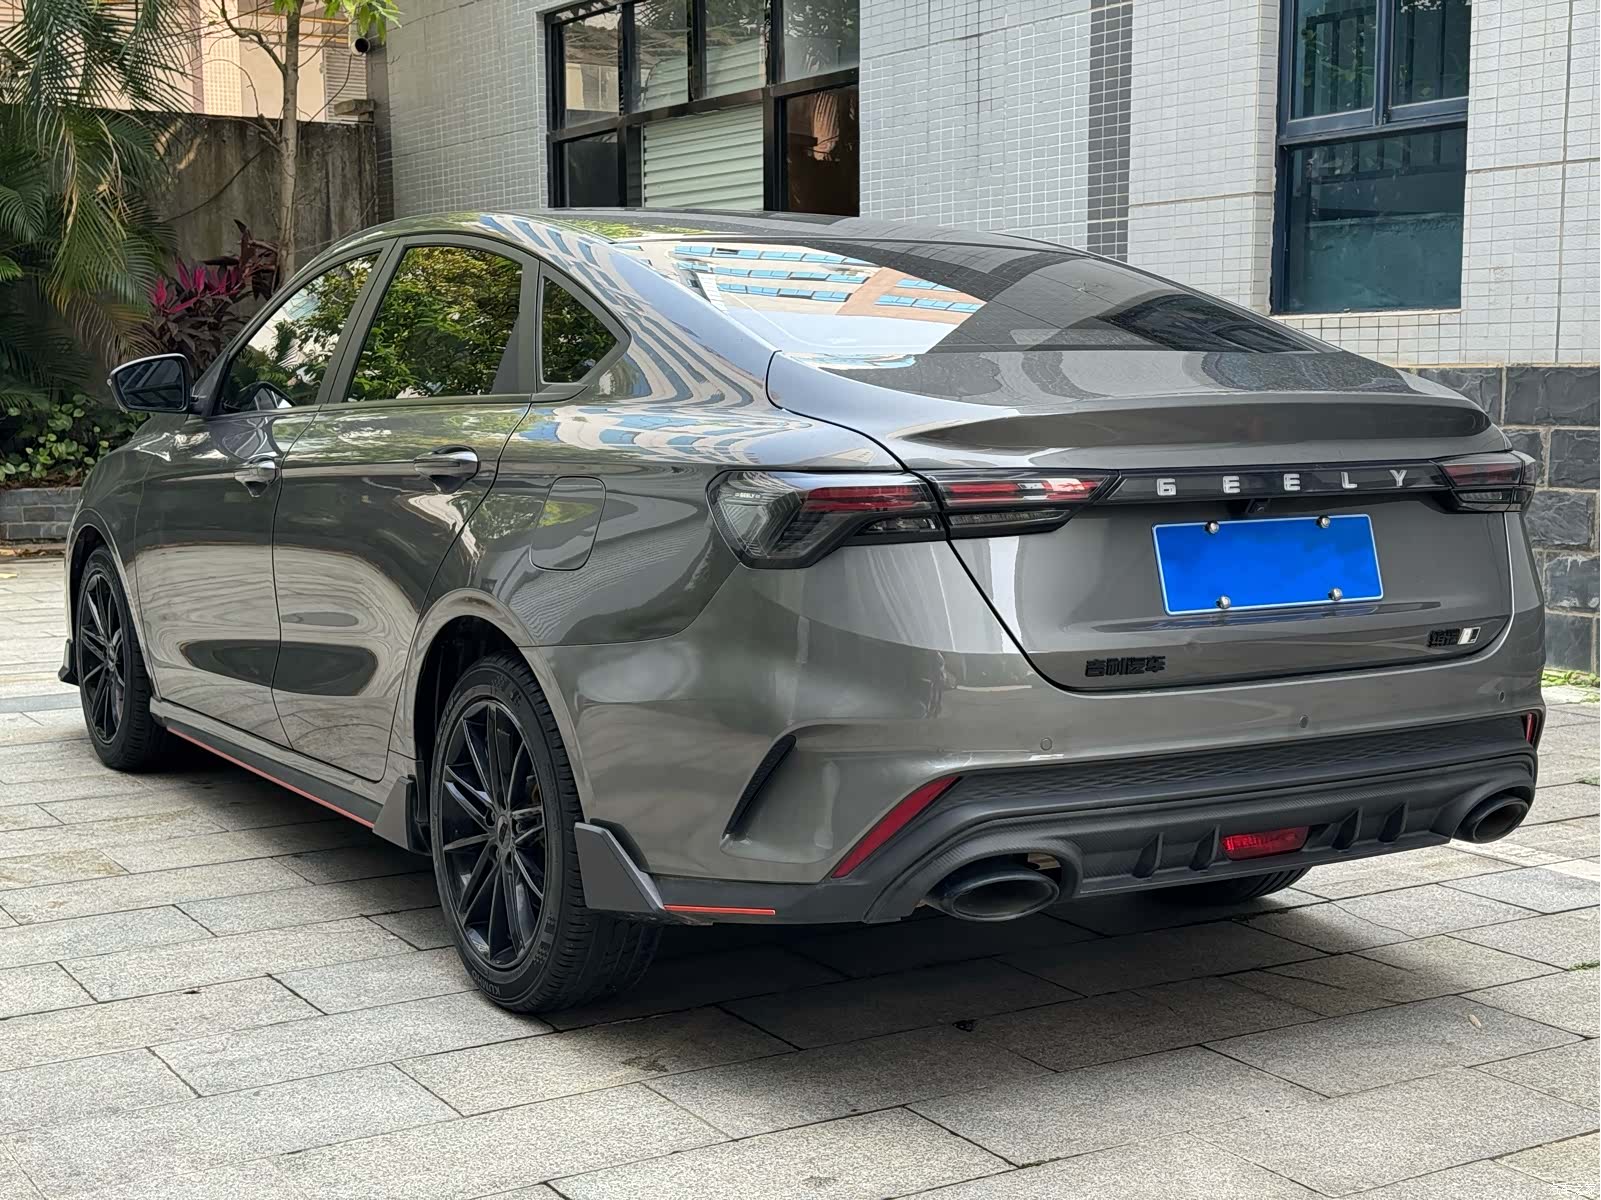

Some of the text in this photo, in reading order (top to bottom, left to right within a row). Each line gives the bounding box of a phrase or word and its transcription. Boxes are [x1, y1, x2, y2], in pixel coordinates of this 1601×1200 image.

[1156, 469, 1408, 497] GEELY
[1085, 655, 1166, 678] 吉利汽车
